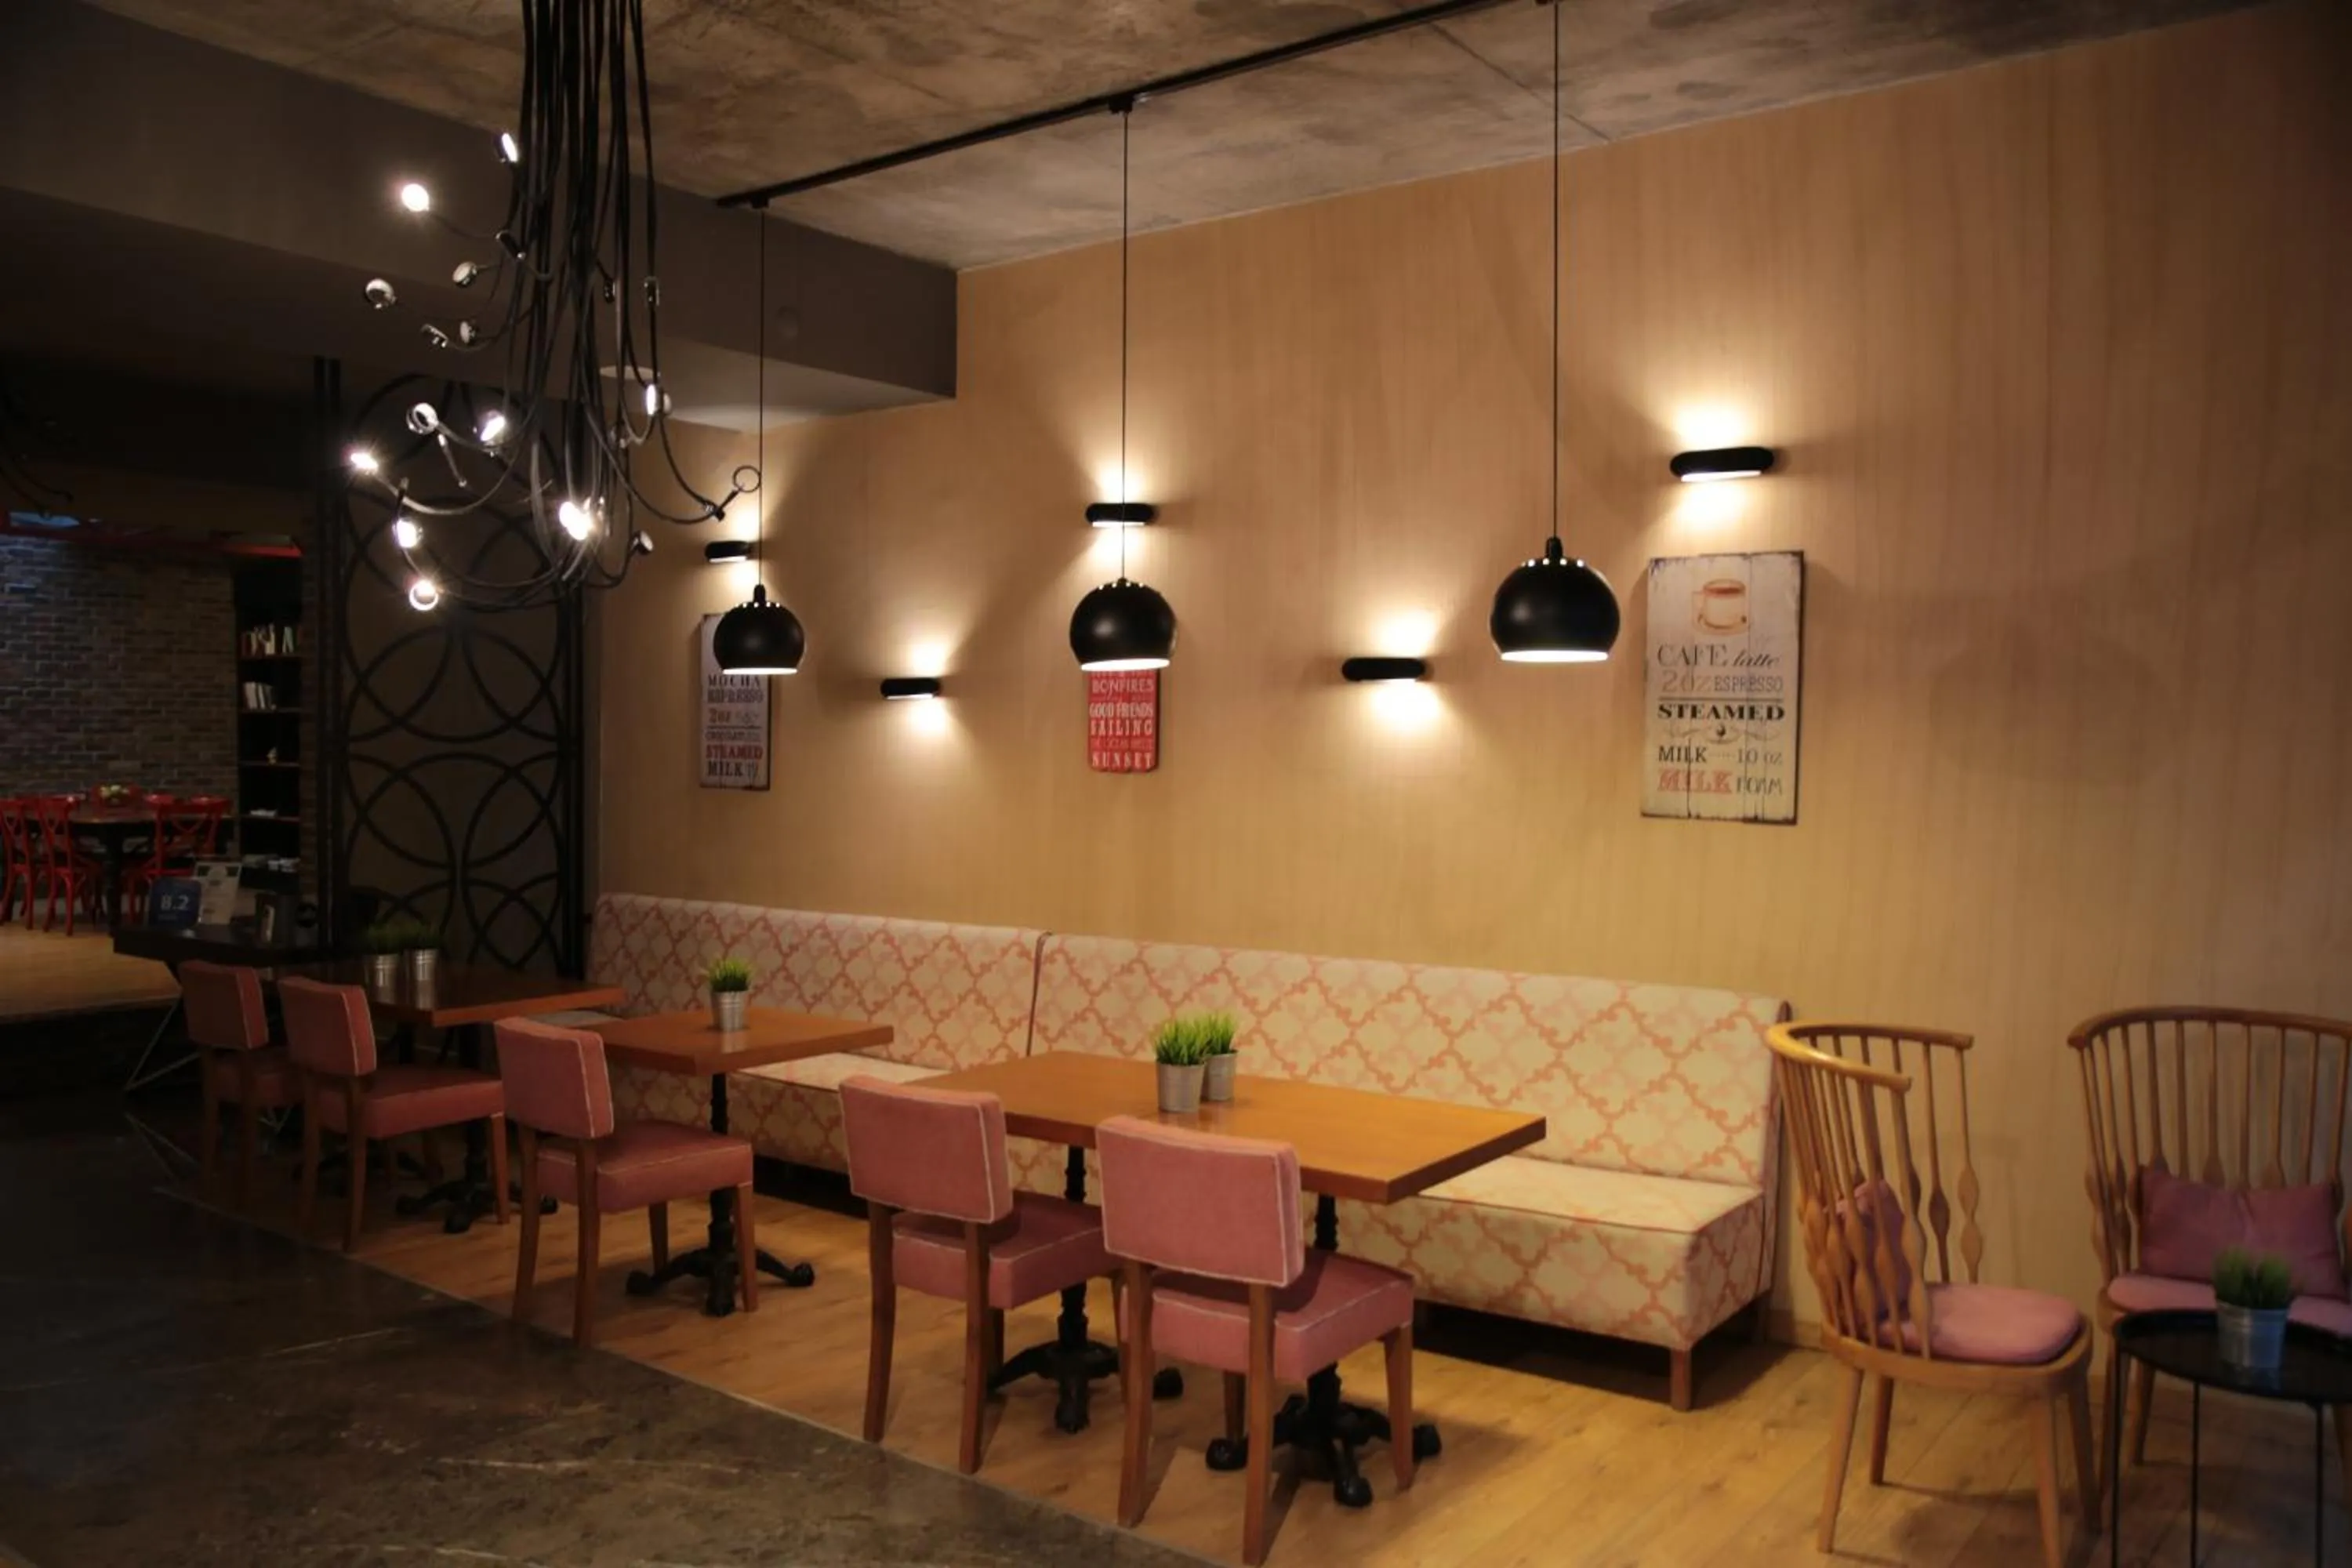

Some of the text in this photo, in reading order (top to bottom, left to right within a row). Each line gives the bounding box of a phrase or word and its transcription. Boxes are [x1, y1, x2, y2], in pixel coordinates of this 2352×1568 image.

[708, 674, 760, 687] MOCHA
[1092, 678, 1154, 693] BONFIRES
[1714, 676, 1783, 693] ESPRESSO
[1657, 704, 1785, 721] STEAMED
[1658, 746, 1707, 763] MILK
[708, 760, 743, 776] MILK
[1657, 768, 1783, 796] MILK FOAM
